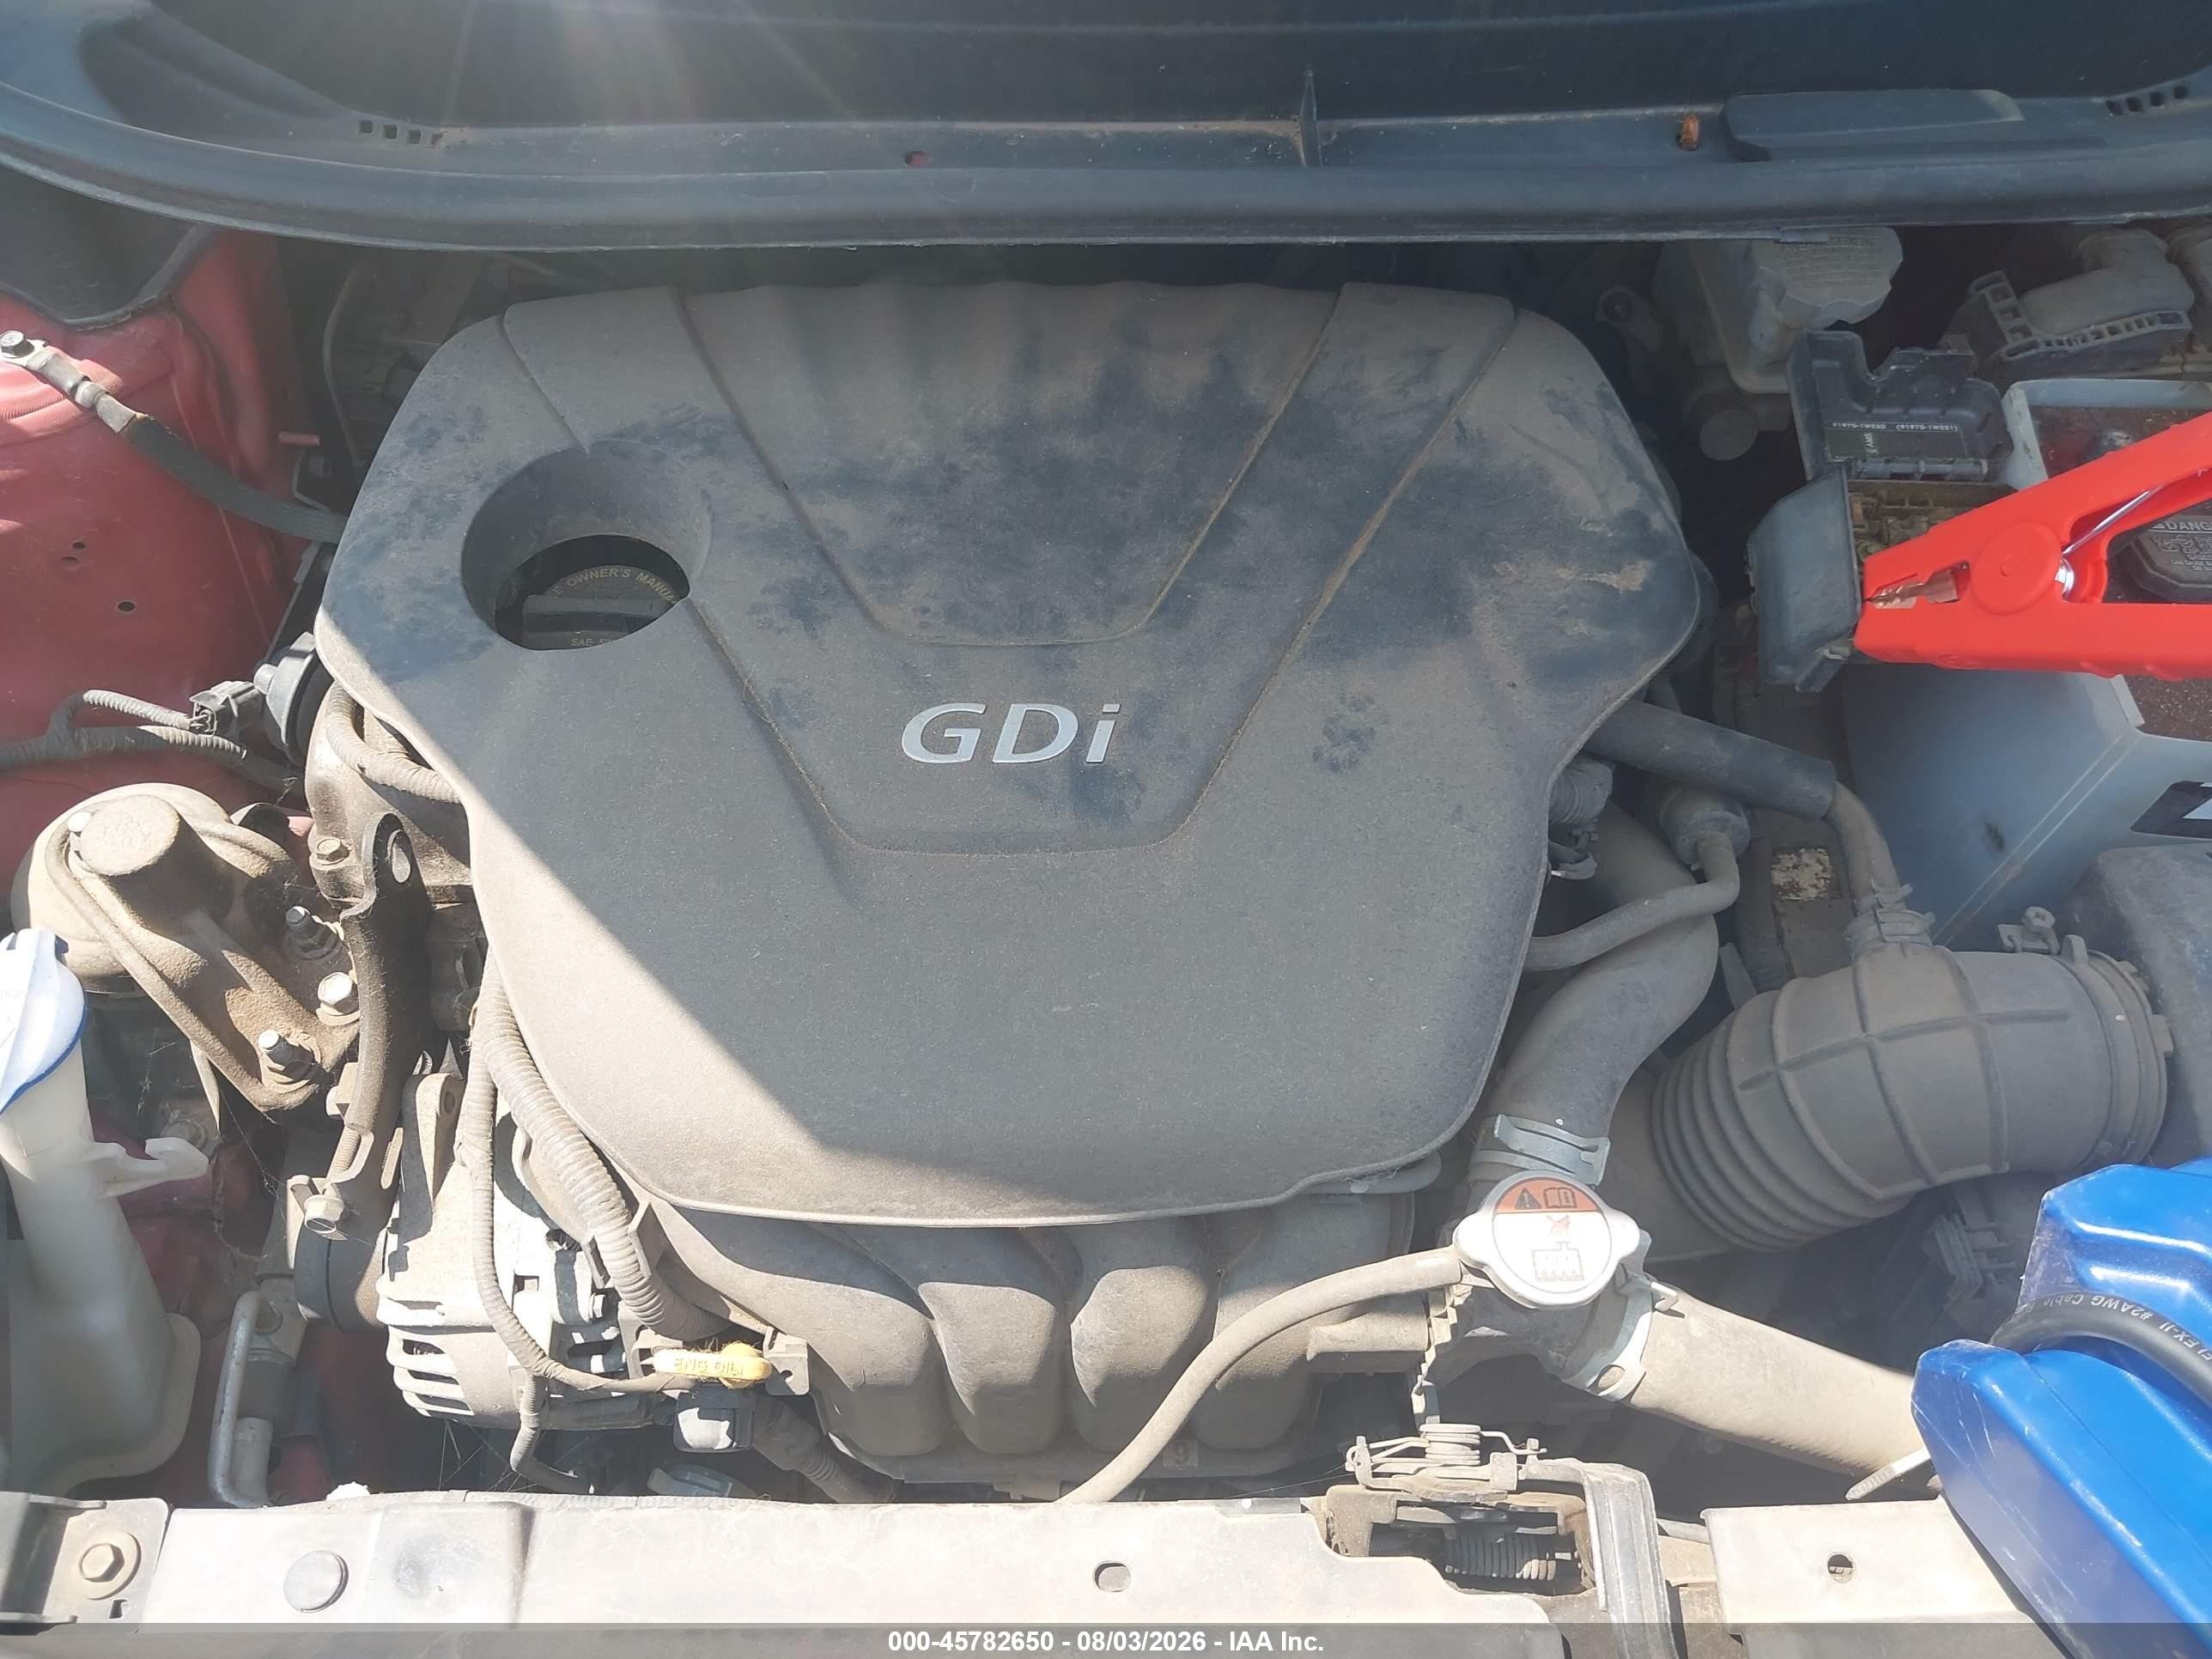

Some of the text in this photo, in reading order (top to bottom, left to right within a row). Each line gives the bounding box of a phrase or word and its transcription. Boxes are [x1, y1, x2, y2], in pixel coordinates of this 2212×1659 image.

[567, 568, 632, 587] OWNER'S
[635, 573, 679, 605] MANUA
[901, 702, 1121, 764] GDi
[2090, 1295, 2154, 1321] #2AWG
